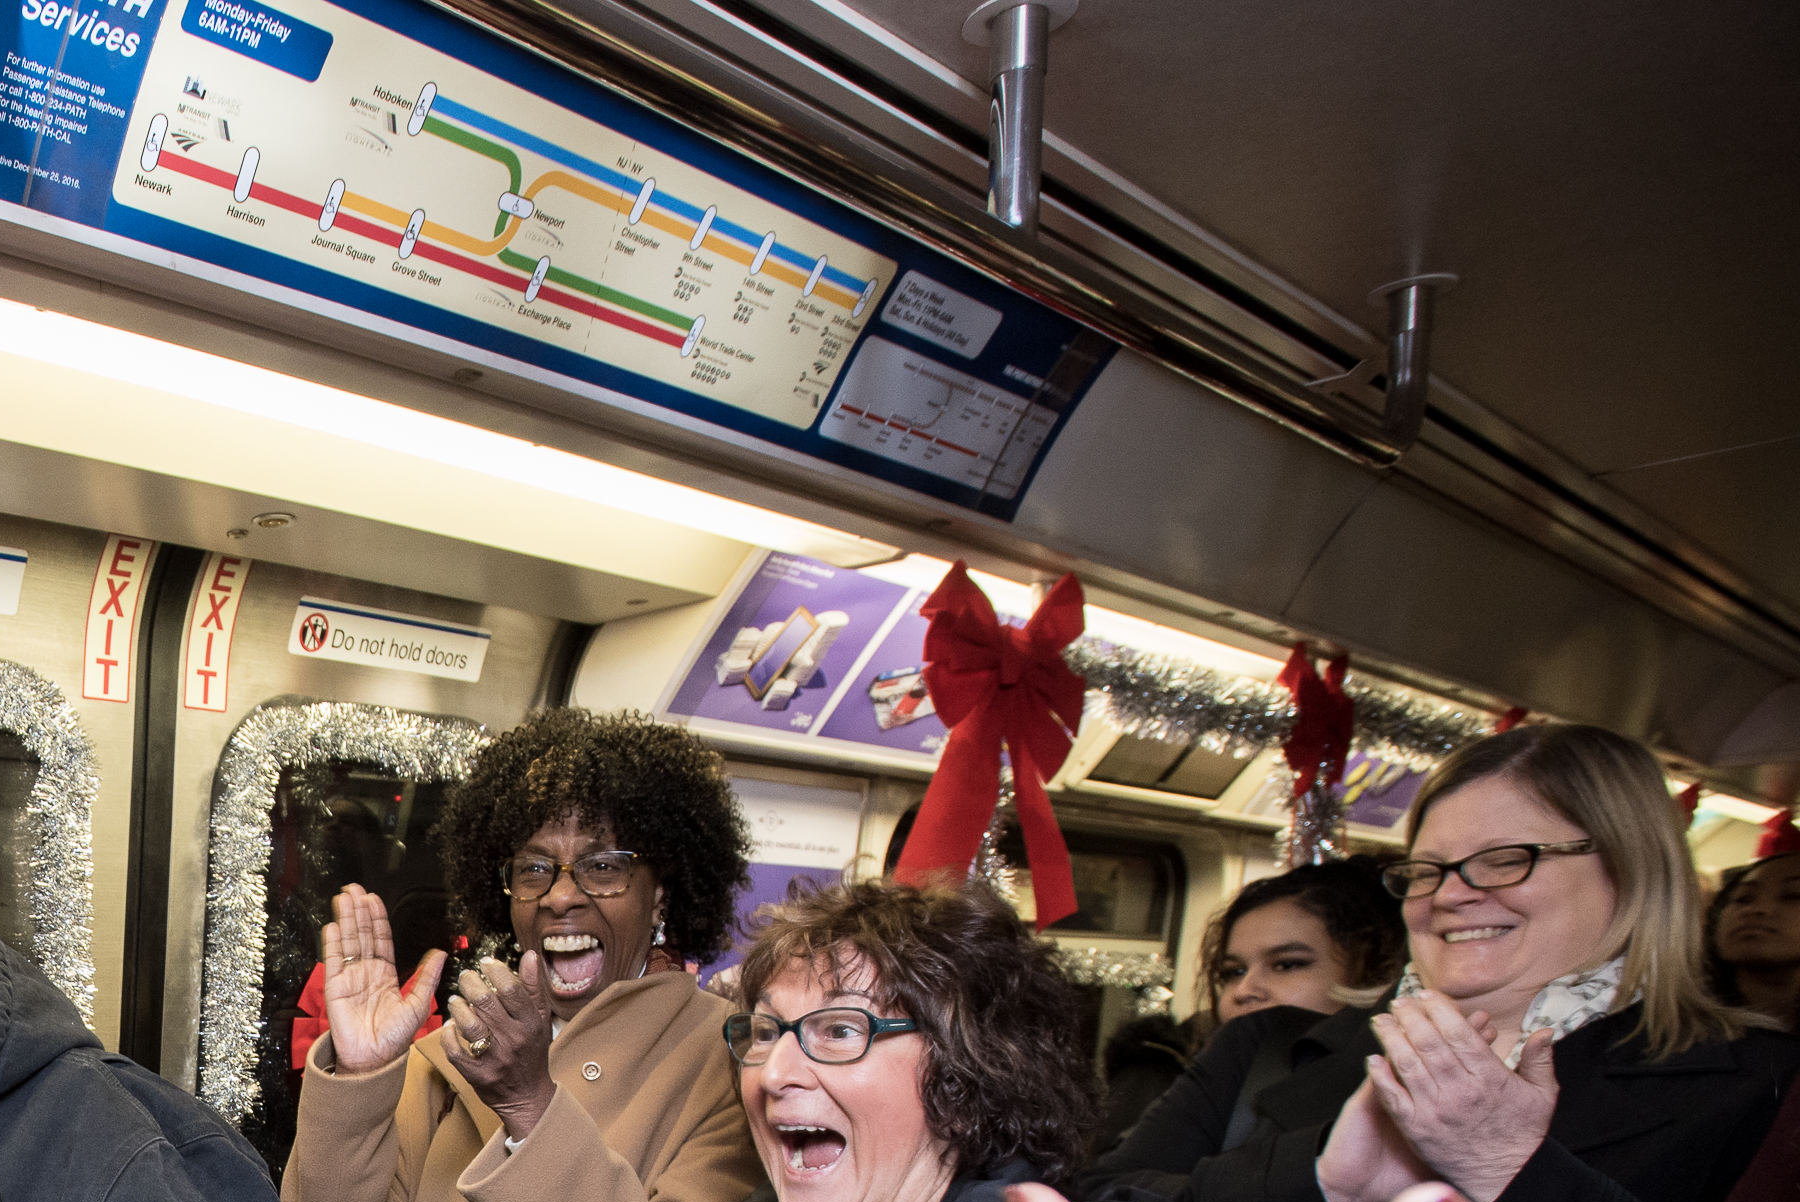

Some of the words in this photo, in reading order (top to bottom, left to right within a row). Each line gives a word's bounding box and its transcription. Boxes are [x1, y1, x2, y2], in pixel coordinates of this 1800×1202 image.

[21, 0, 141, 58] Services
[198, 11, 262, 49] 6AM-11PM
[204, 0, 292, 43] Monday-Friday
[6, 51, 21, 66] For
[21, 56, 47, 75] further
[47, 66, 90, 91] inormation
[90, 83, 106, 97] use
[2, 66, 44, 90] Passenger
[88, 95, 126, 119] Telephone
[8, 84, 23, 97] call
[24, 88, 88, 119] 1-800234-PATH
[372, 85, 413, 111] Hoboken
[10, 98, 23, 112] the
[54, 113, 88, 135] impaired
[50, 170, 61, 184] 25,
[134, 173, 173, 196] Newark
[226, 204, 266, 227] Harrison
[533, 208, 566, 229] Newport
[311, 234, 345, 254] Journal
[345, 244, 376, 264] Square
[614, 240, 636, 256] Street
[621, 227, 661, 250] Christopher
[391, 261, 417, 278] Grove
[417, 269, 443, 287] Street
[681, 251, 695, 264] 9th
[694, 256, 714, 272] Street
[756, 282, 776, 297] Street
[517, 304, 551, 325] Exchange
[552, 315, 572, 331] Place
[95, 539, 141, 695] EXIT
[196, 556, 241, 705] EXIT
[331, 628, 355, 651] Do
[359, 637, 386, 657] not
[388, 638, 424, 662] hold
[425, 645, 468, 670] doors
